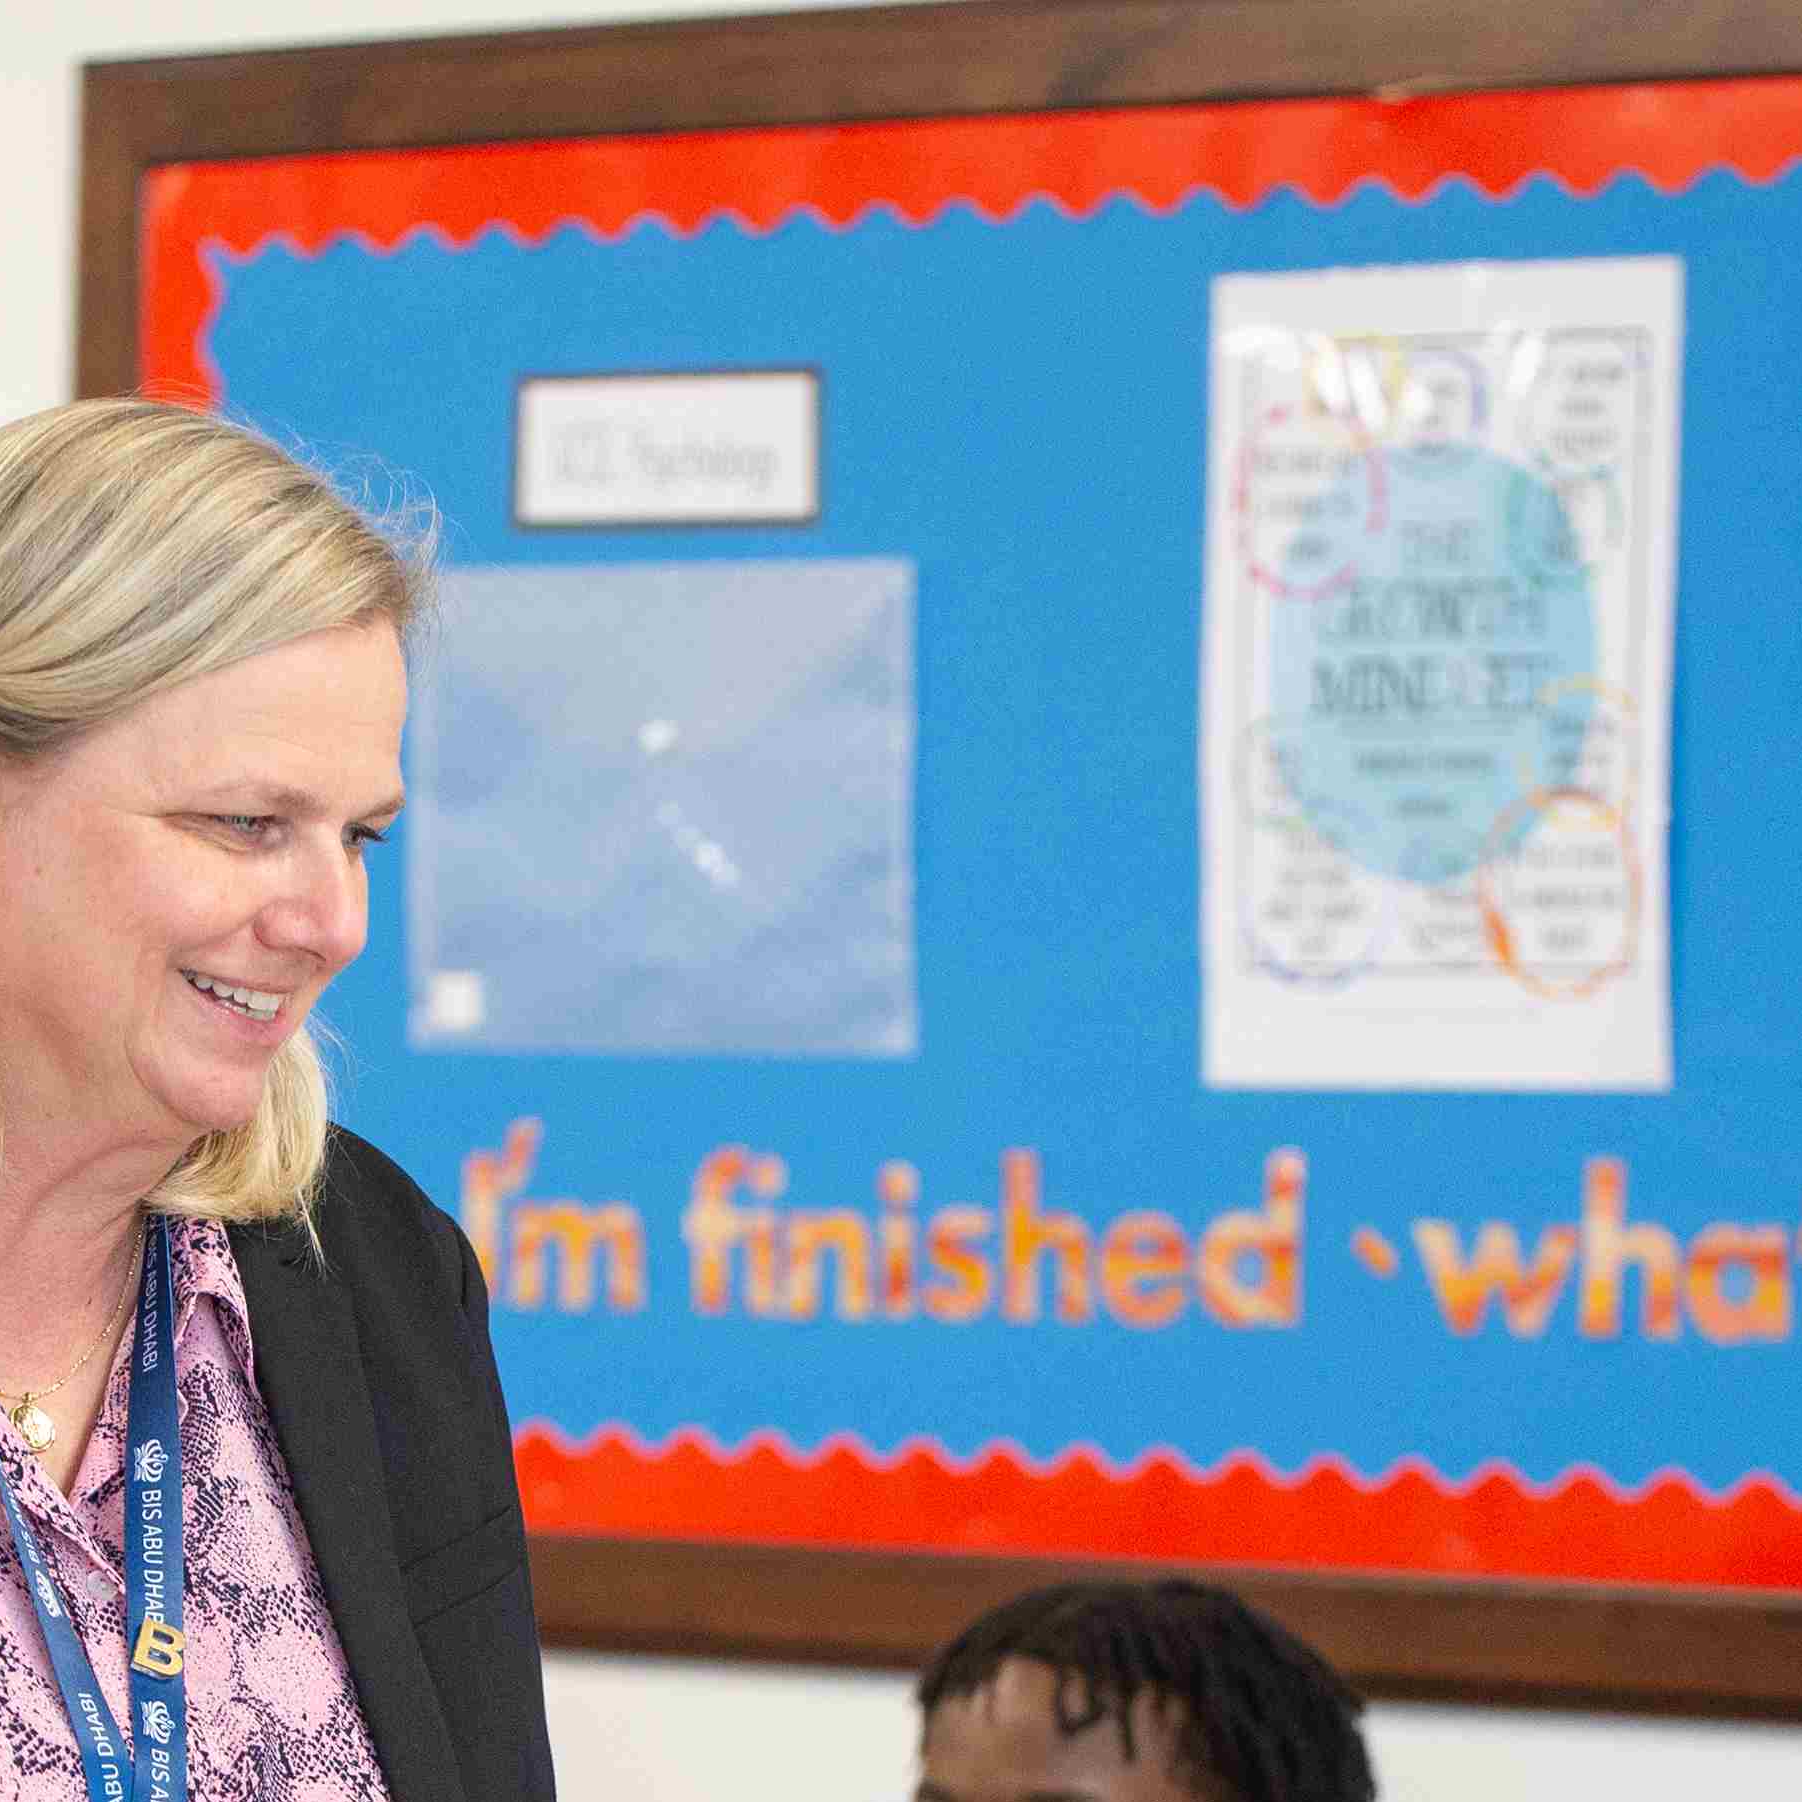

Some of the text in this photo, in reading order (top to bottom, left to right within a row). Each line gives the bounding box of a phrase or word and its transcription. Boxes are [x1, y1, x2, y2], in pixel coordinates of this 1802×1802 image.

[462, 1118, 646, 1312] I'm
[684, 1146, 1304, 1327] finished
[143, 1311, 158, 1373] DHABI
[142, 1489, 163, 1521] BIS
[143, 1524, 164, 1564] ABU
[78, 1692, 115, 1758] DHABI
[150, 1751, 171, 1787] BIS
